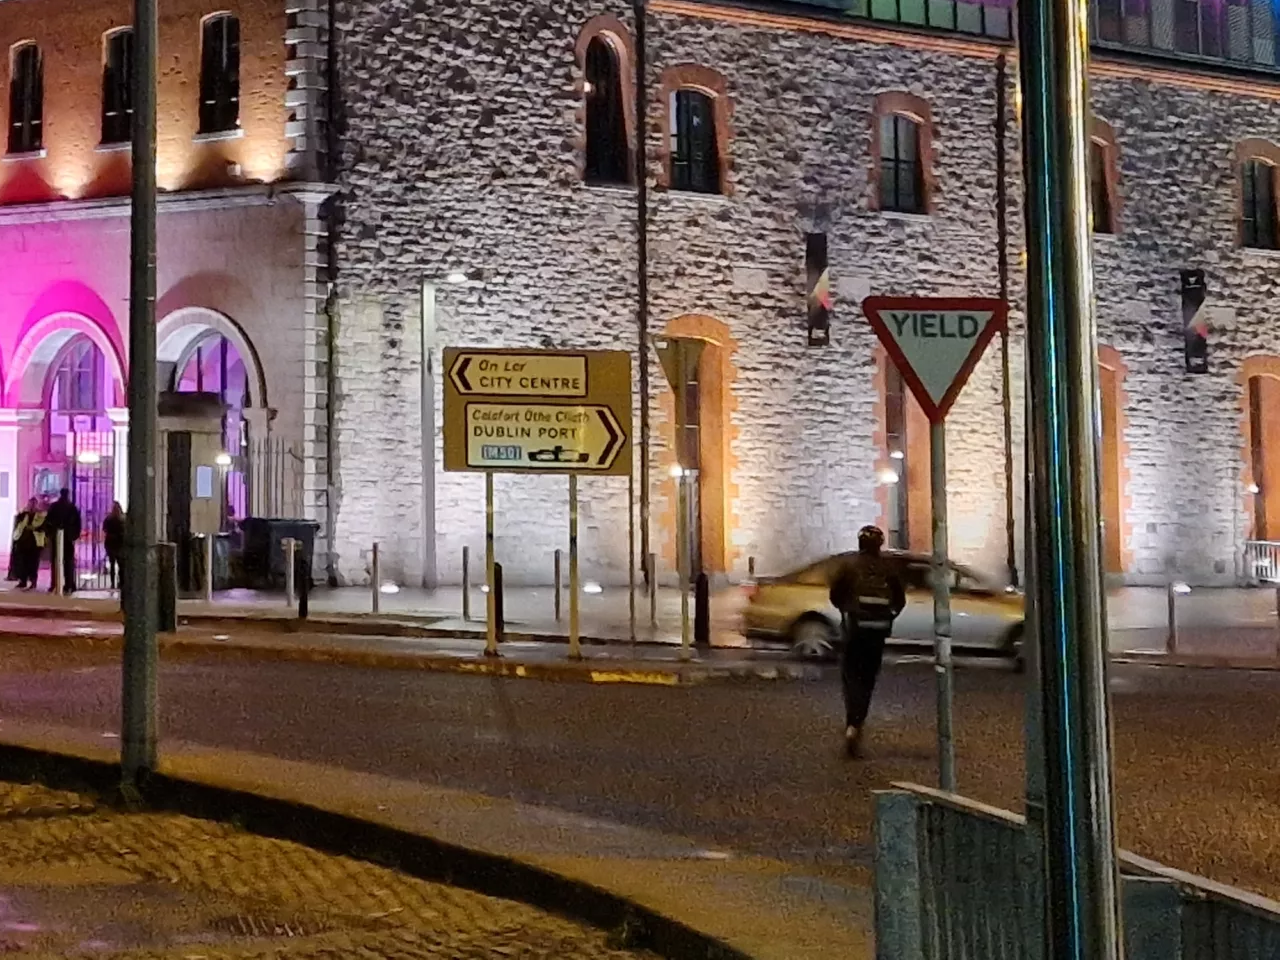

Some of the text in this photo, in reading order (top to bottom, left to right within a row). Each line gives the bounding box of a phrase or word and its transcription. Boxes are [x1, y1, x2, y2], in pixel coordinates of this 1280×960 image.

[890, 313, 979, 339] YIELD
[479, 376, 581, 390] CITY CENTRE
[473, 425, 578, 439] DUBLIN PORT
